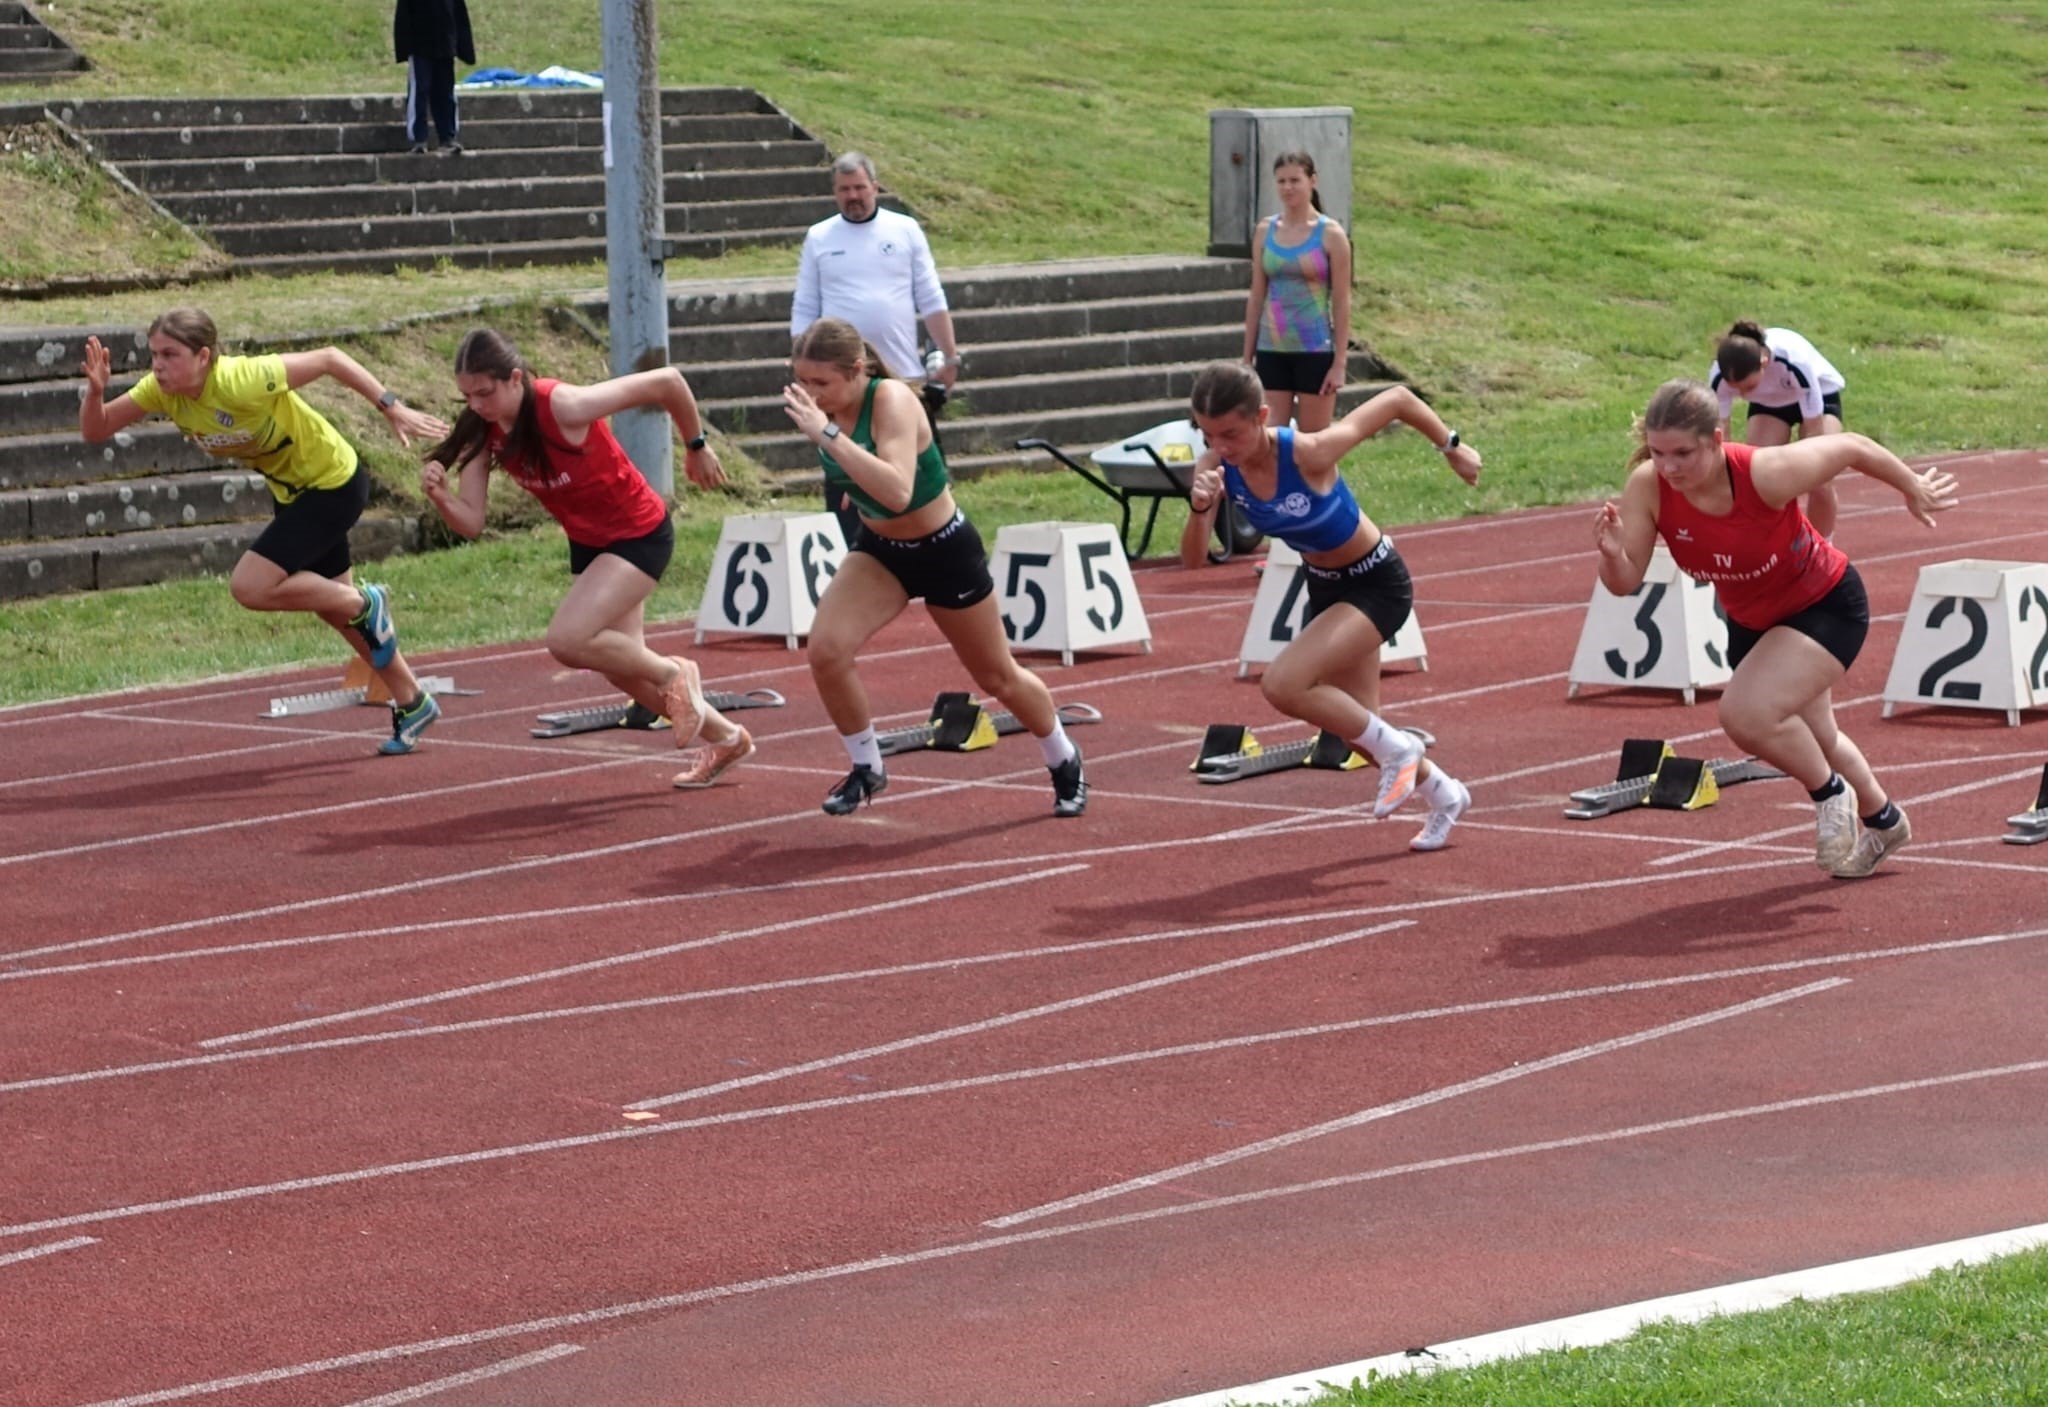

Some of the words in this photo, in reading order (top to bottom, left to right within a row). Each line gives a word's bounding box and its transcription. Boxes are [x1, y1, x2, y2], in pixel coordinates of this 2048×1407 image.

[723, 542, 772, 627] 6
[801, 531, 837, 609] 6
[1002, 553, 1052, 641] 5
[1078, 541, 1123, 632] 5
[1348, 542, 1389, 577] NIKE
[1713, 553, 1732, 569] TV
[1604, 582, 1662, 679] 3
[1918, 596, 1988, 700] 2
